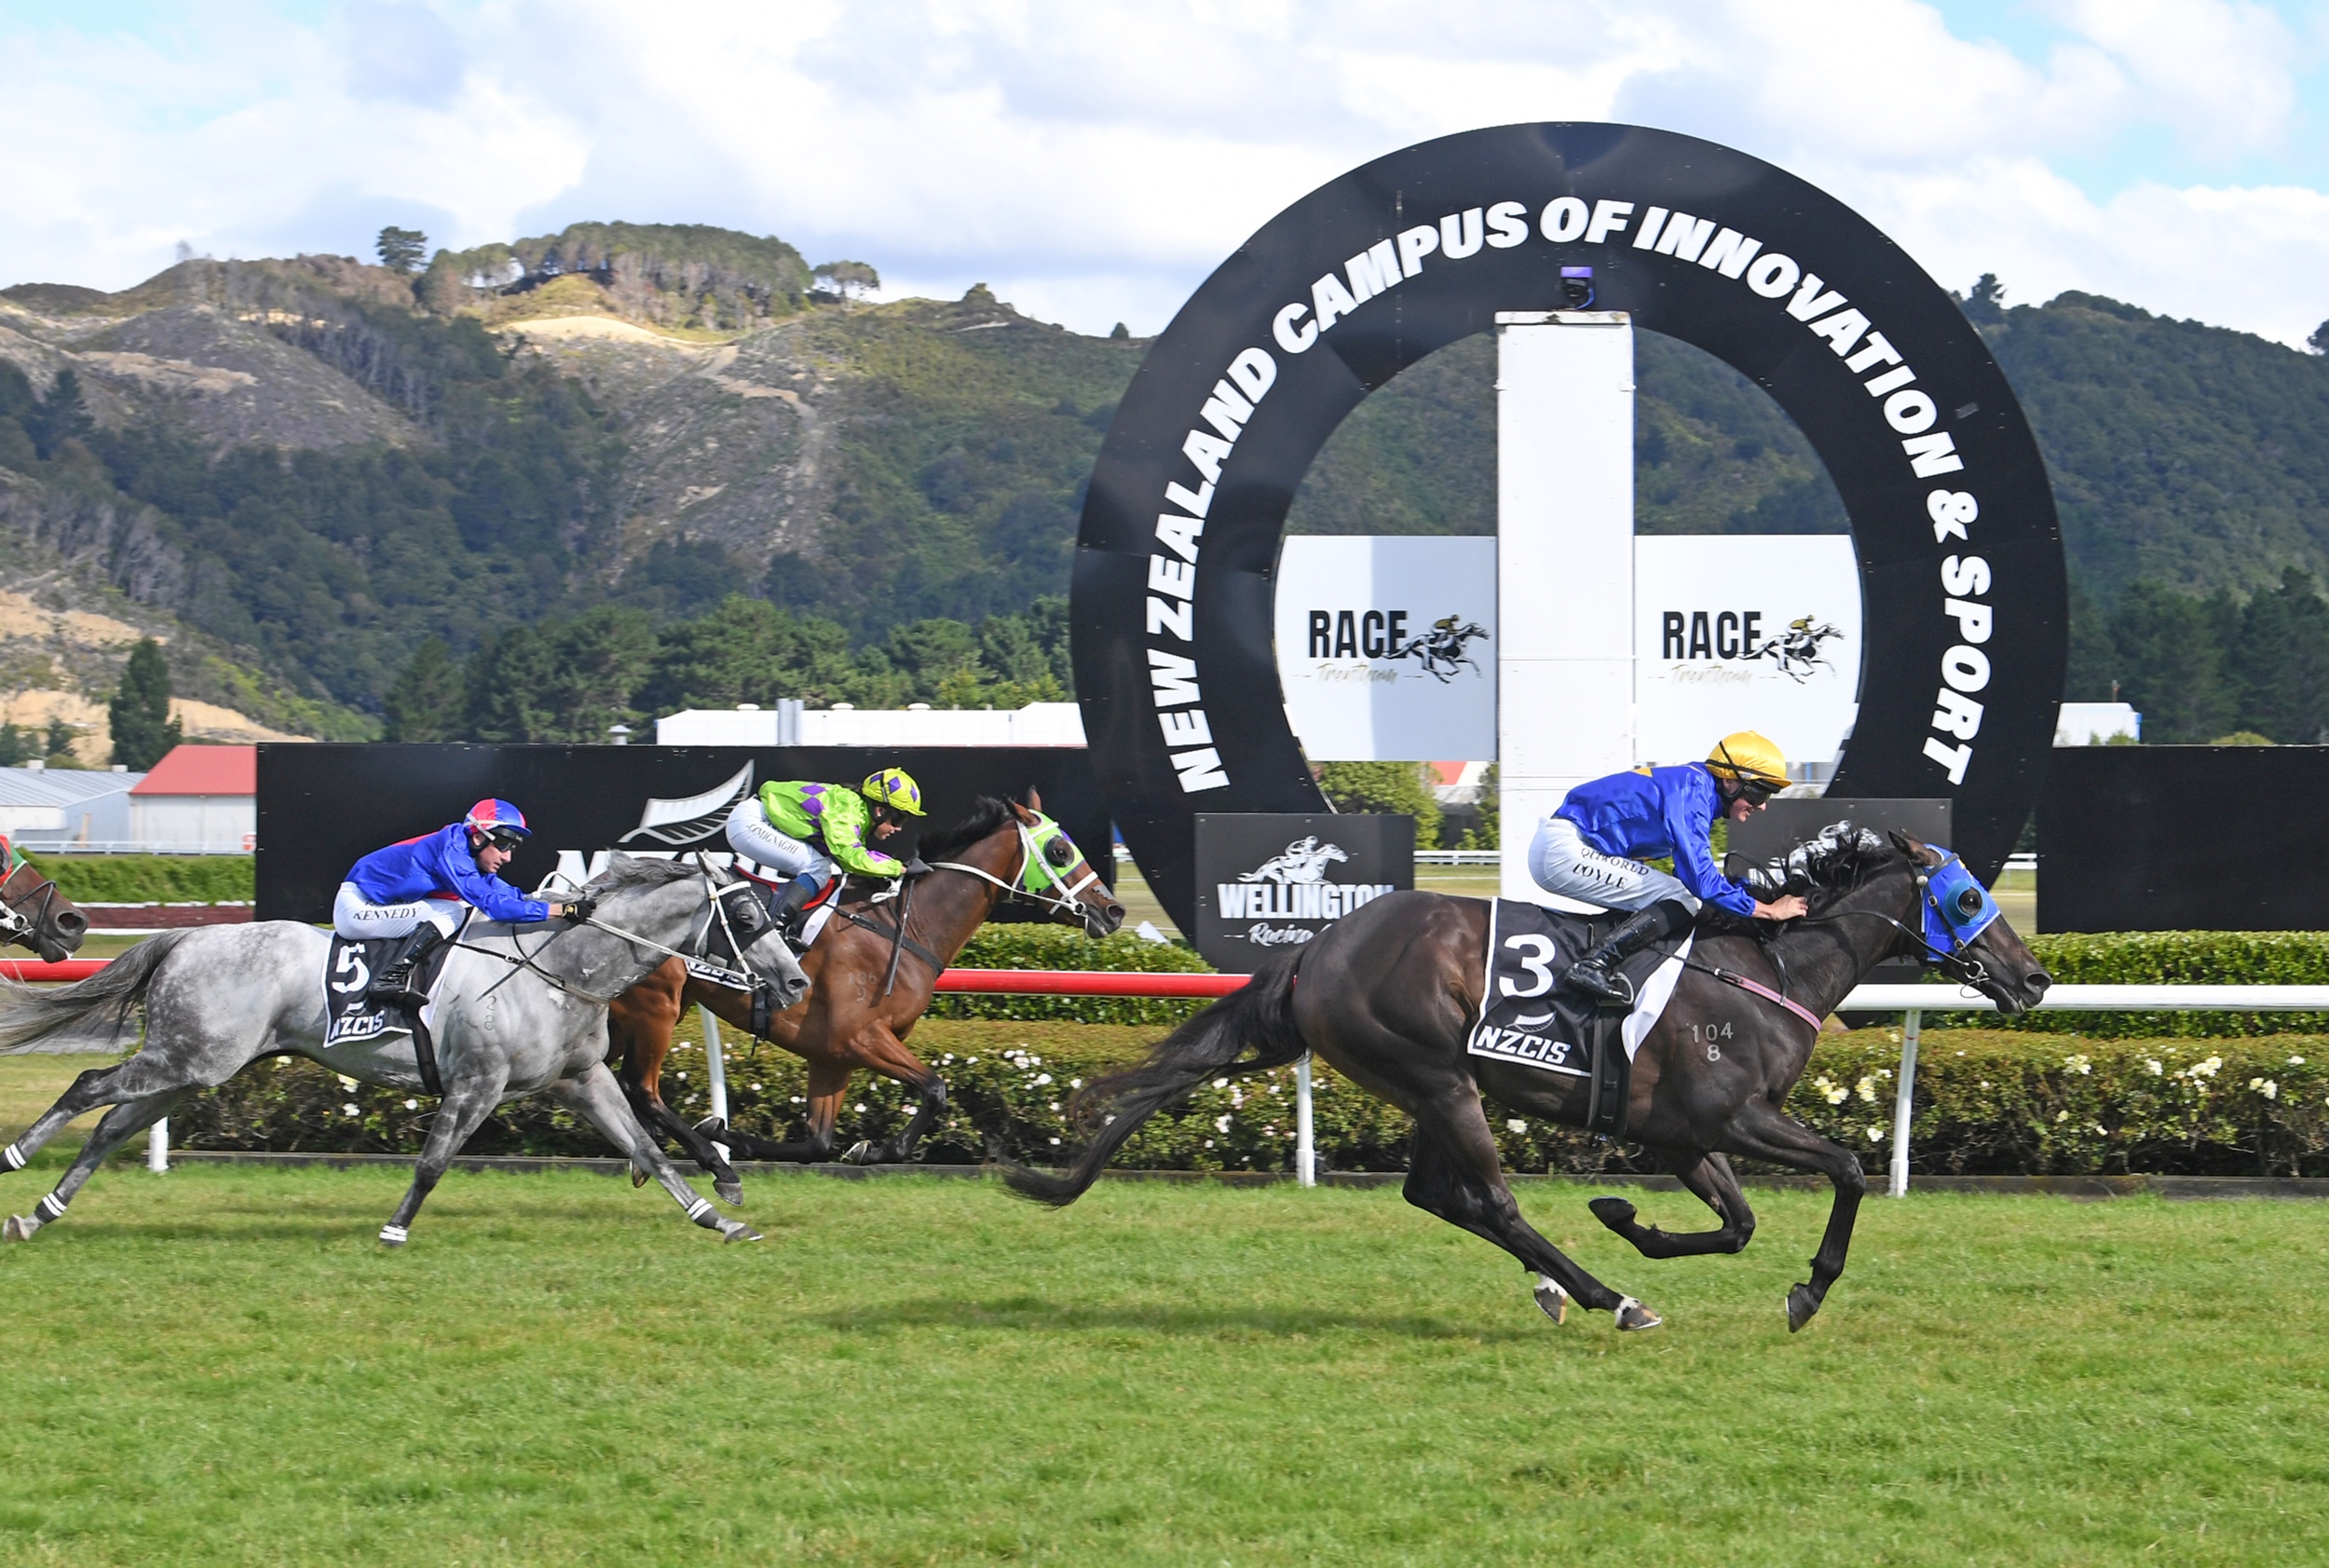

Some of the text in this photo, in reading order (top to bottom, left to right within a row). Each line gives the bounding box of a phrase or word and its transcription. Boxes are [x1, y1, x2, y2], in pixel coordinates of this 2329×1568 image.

[1147, 198, 1992, 792] NEW ZEALAND CAMPUS OF INNOVATION & SPORT
[1309, 610, 1408, 659] RACE
[1663, 611, 1762, 660] RACE
[1573, 863, 1628, 890] DOYLE
[353, 907, 421, 921] KENNEDY
[332, 943, 370, 993] 5
[1498, 934, 1556, 998] 3
[1475, 1025, 1572, 1065] NZCIS
[1692, 1022, 1734, 1043] 104
[1707, 1044, 1721, 1062] 8
